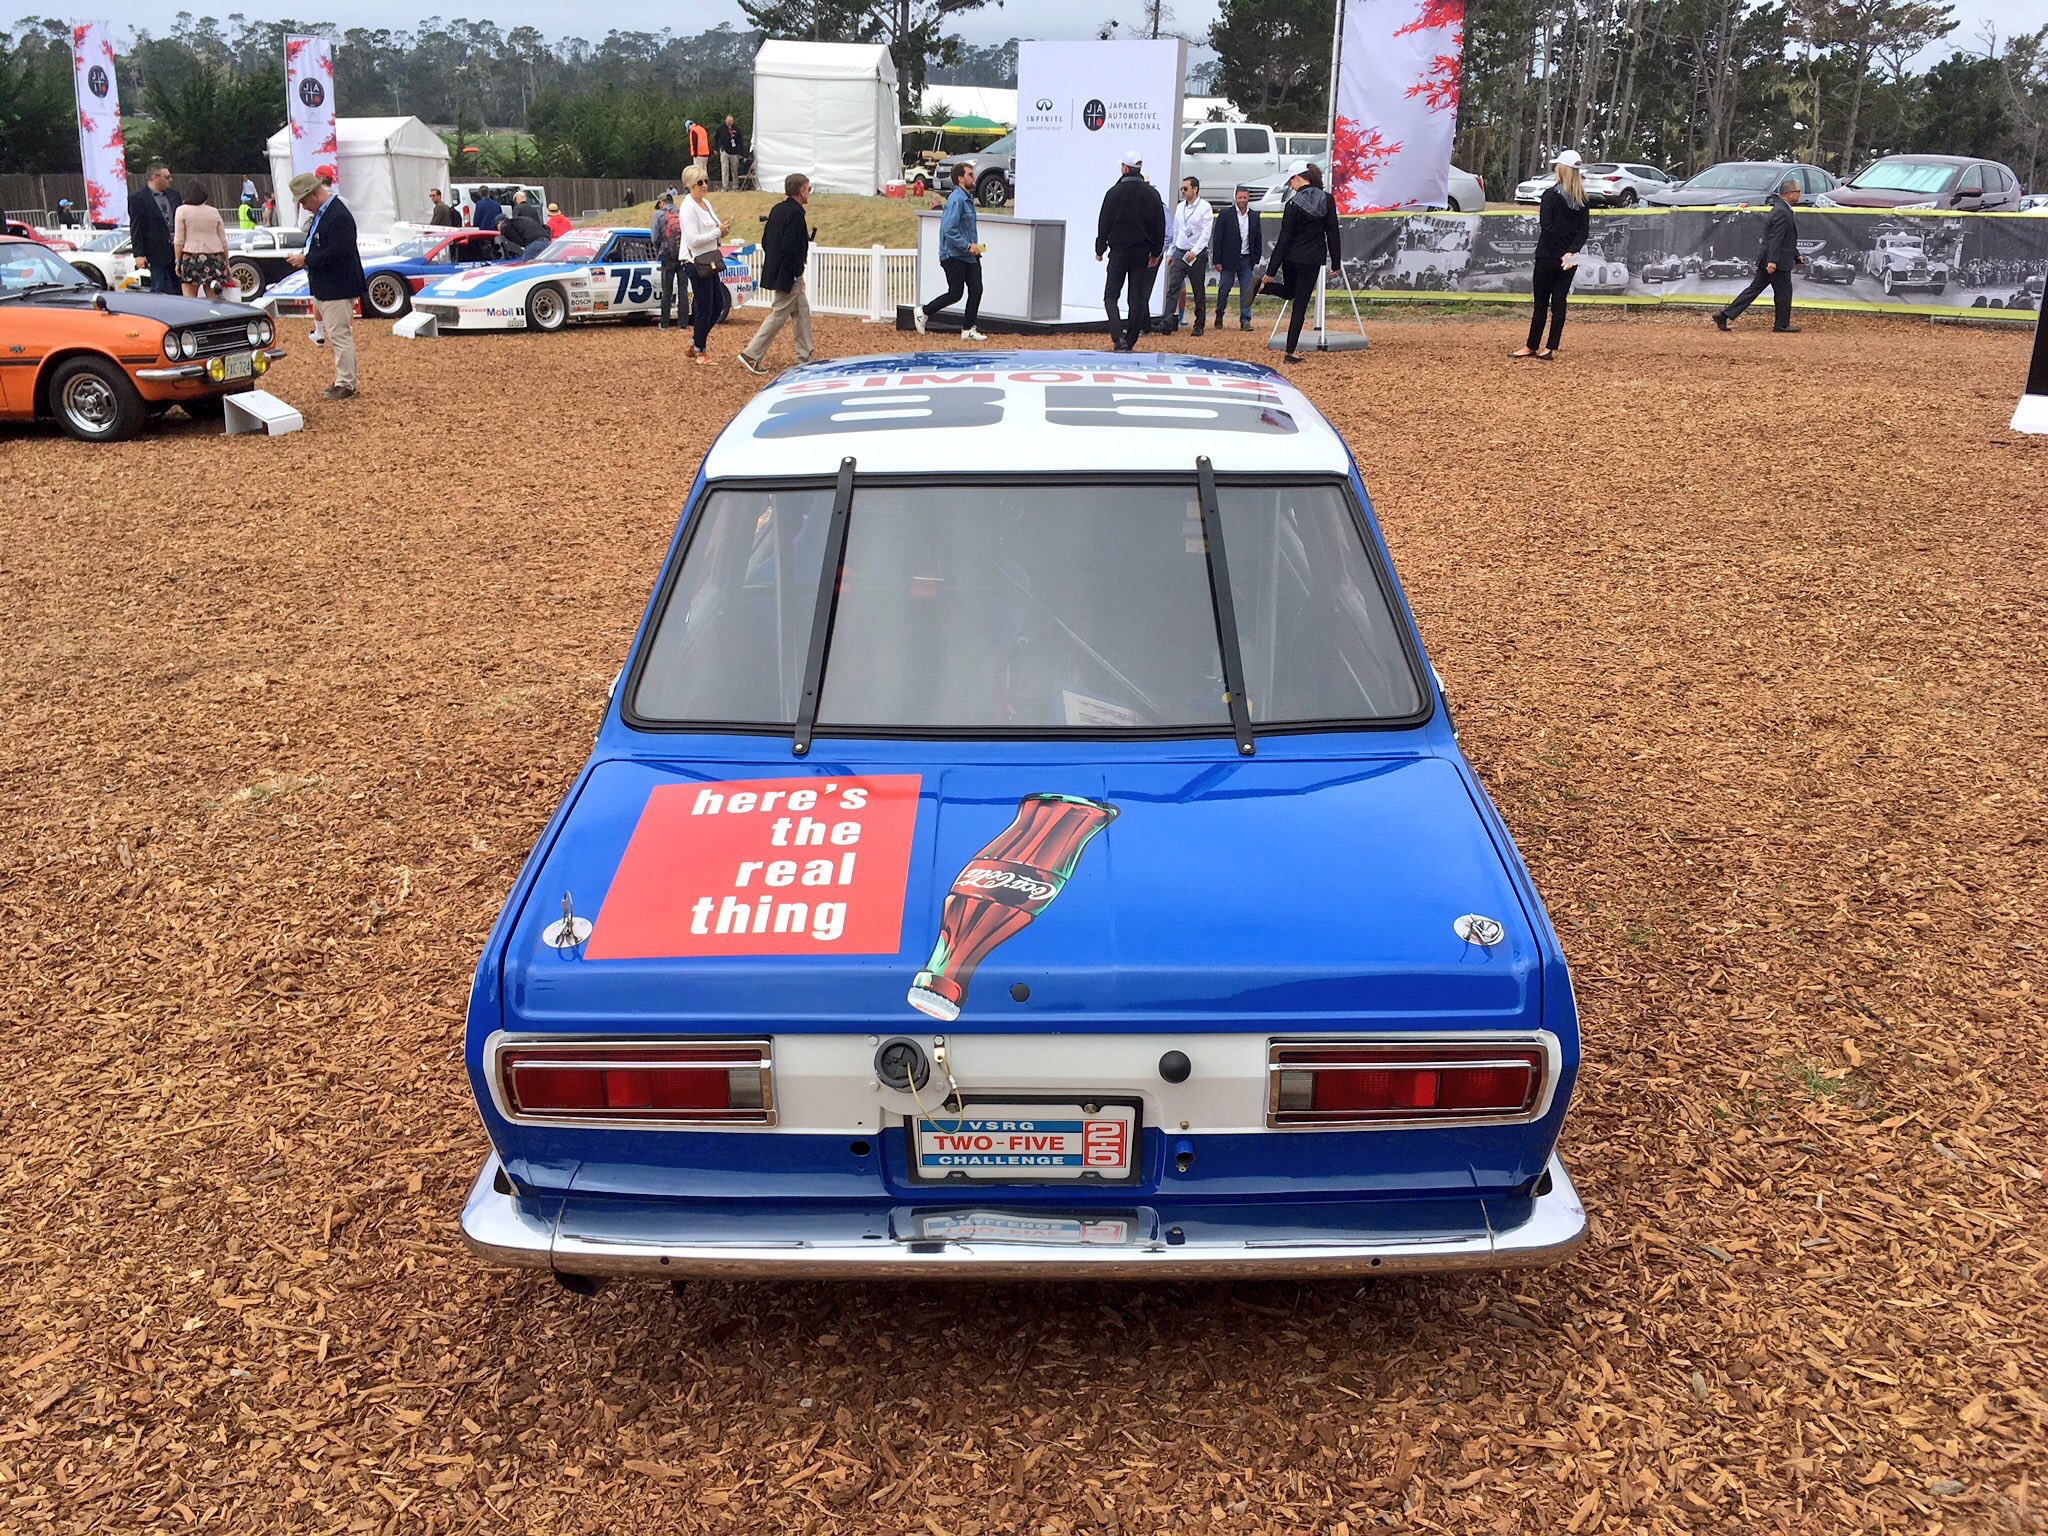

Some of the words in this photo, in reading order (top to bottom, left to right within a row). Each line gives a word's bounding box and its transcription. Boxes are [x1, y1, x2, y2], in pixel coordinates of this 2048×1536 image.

[1108, 112, 1157, 120] AUTOMOTIVE
[1107, 122, 1161, 130] INVITATIONAL
[1424, 216, 1457, 229] FINISH
[610, 267, 653, 304] 75
[736, 284, 752, 293] Hella
[486, 307, 514, 317] Mobil
[783, 371, 1279, 395] SIMONIZ
[752, 386, 1299, 440] 85
[691, 784, 869, 816] here's
[771, 817, 862, 846] the
[735, 852, 857, 888] real
[690, 895, 848, 941] thing
[968, 1121, 1035, 1131] VSRG
[938, 1155, 1065, 1166] CHALLENGE
